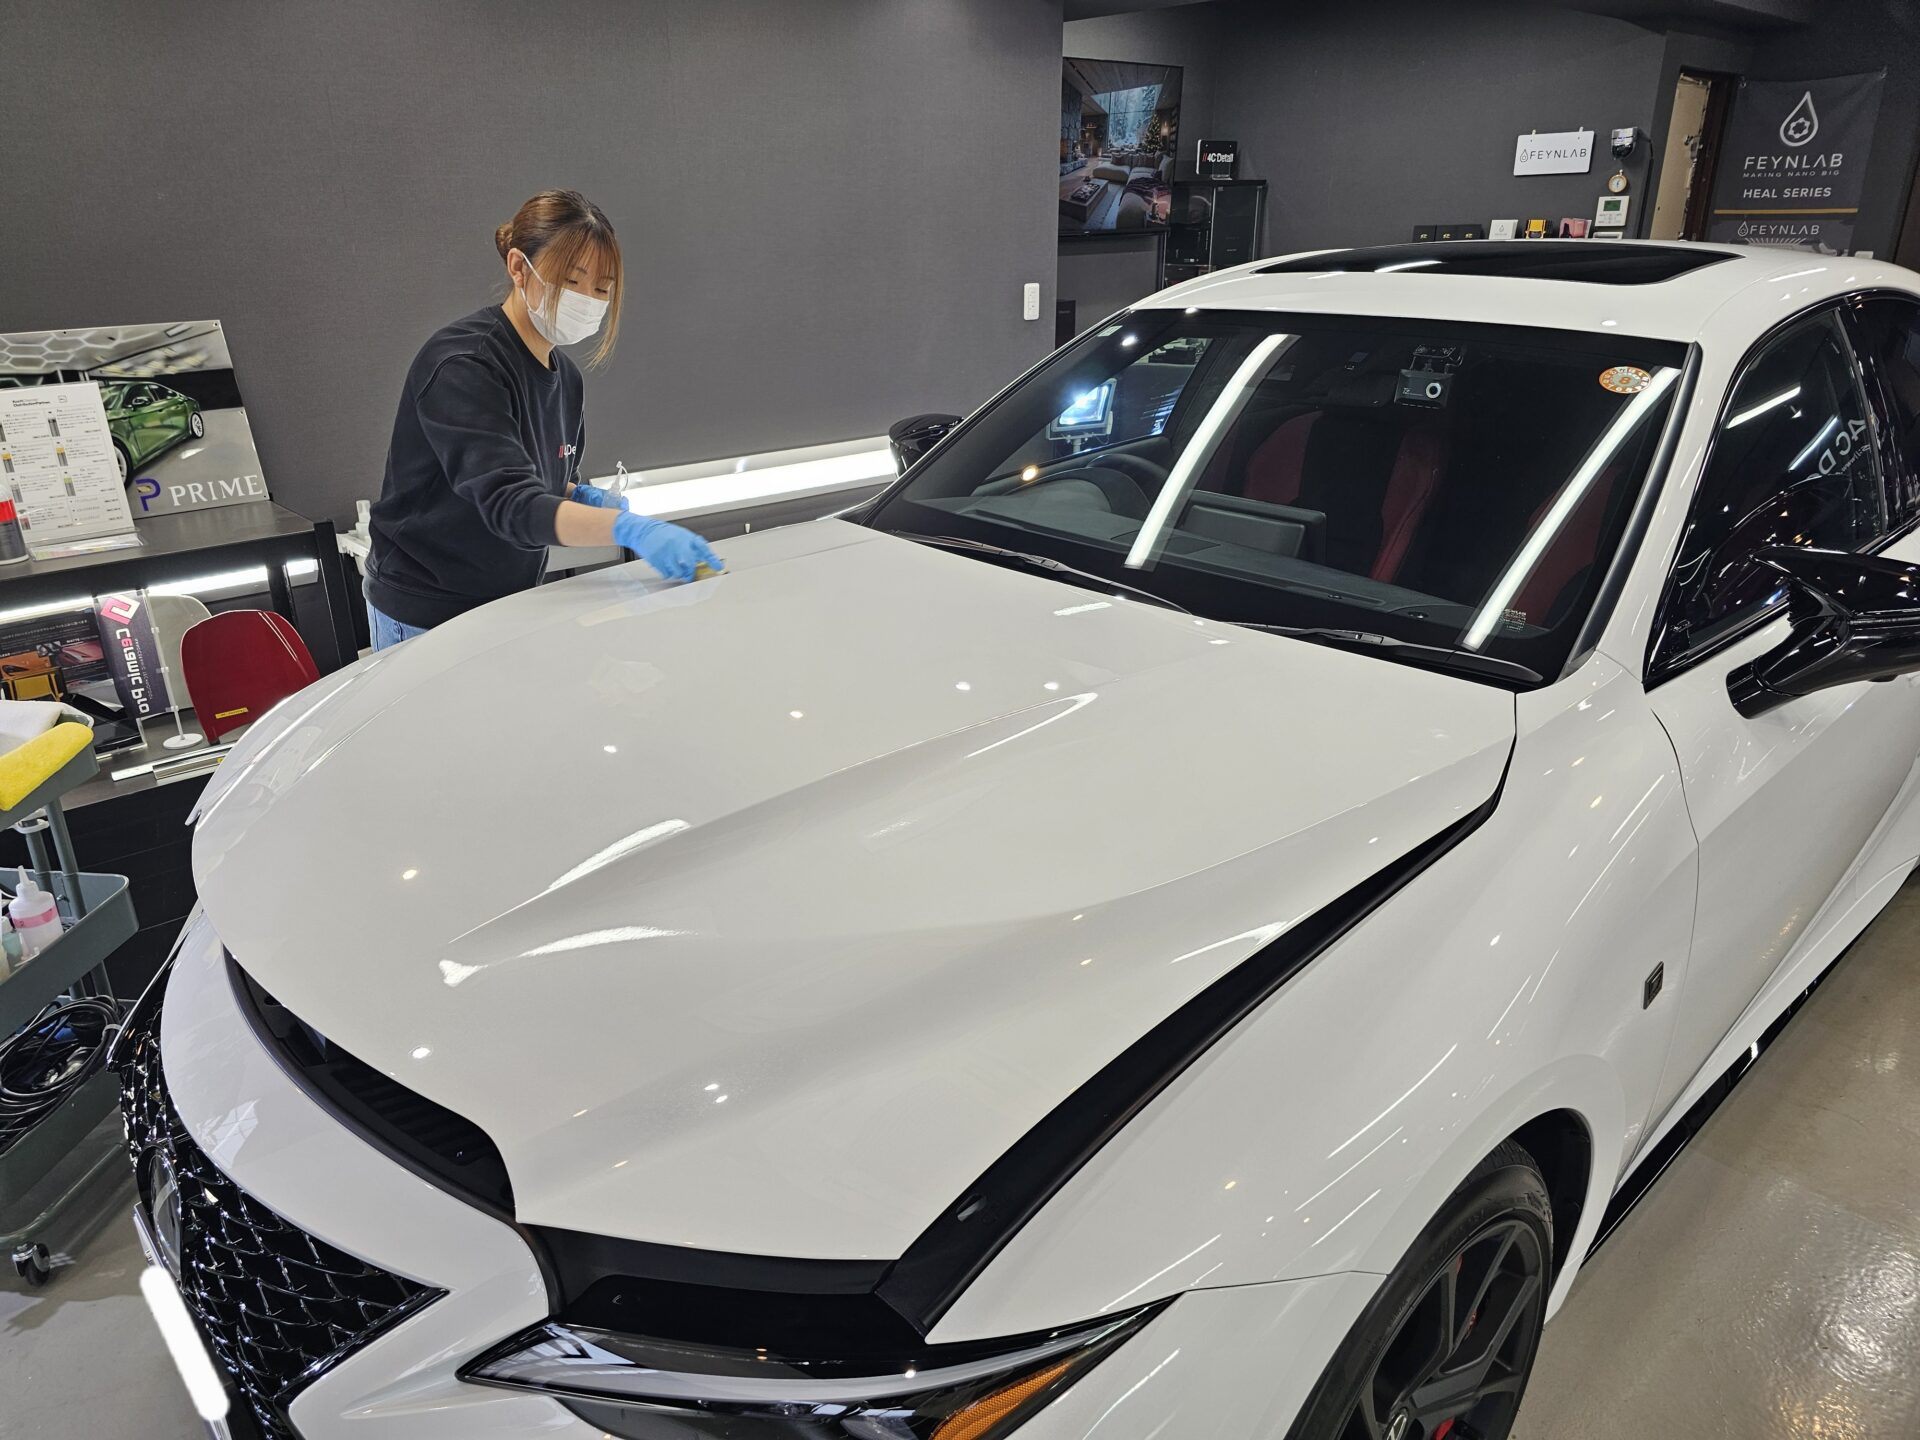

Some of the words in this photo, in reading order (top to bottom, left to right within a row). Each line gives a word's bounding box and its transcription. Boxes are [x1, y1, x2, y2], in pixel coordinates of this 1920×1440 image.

[1217, 152, 1233, 162] Detail
[1529, 148, 1588, 161] FEYNLAB
[1743, 153, 1844, 170] FEYNLAB
[1743, 187, 1778, 199] HEAL
[1783, 186, 1832, 198] SERIES
[1749, 224, 1820, 236] FEYNLAB
[167, 474, 263, 507] PRIME
